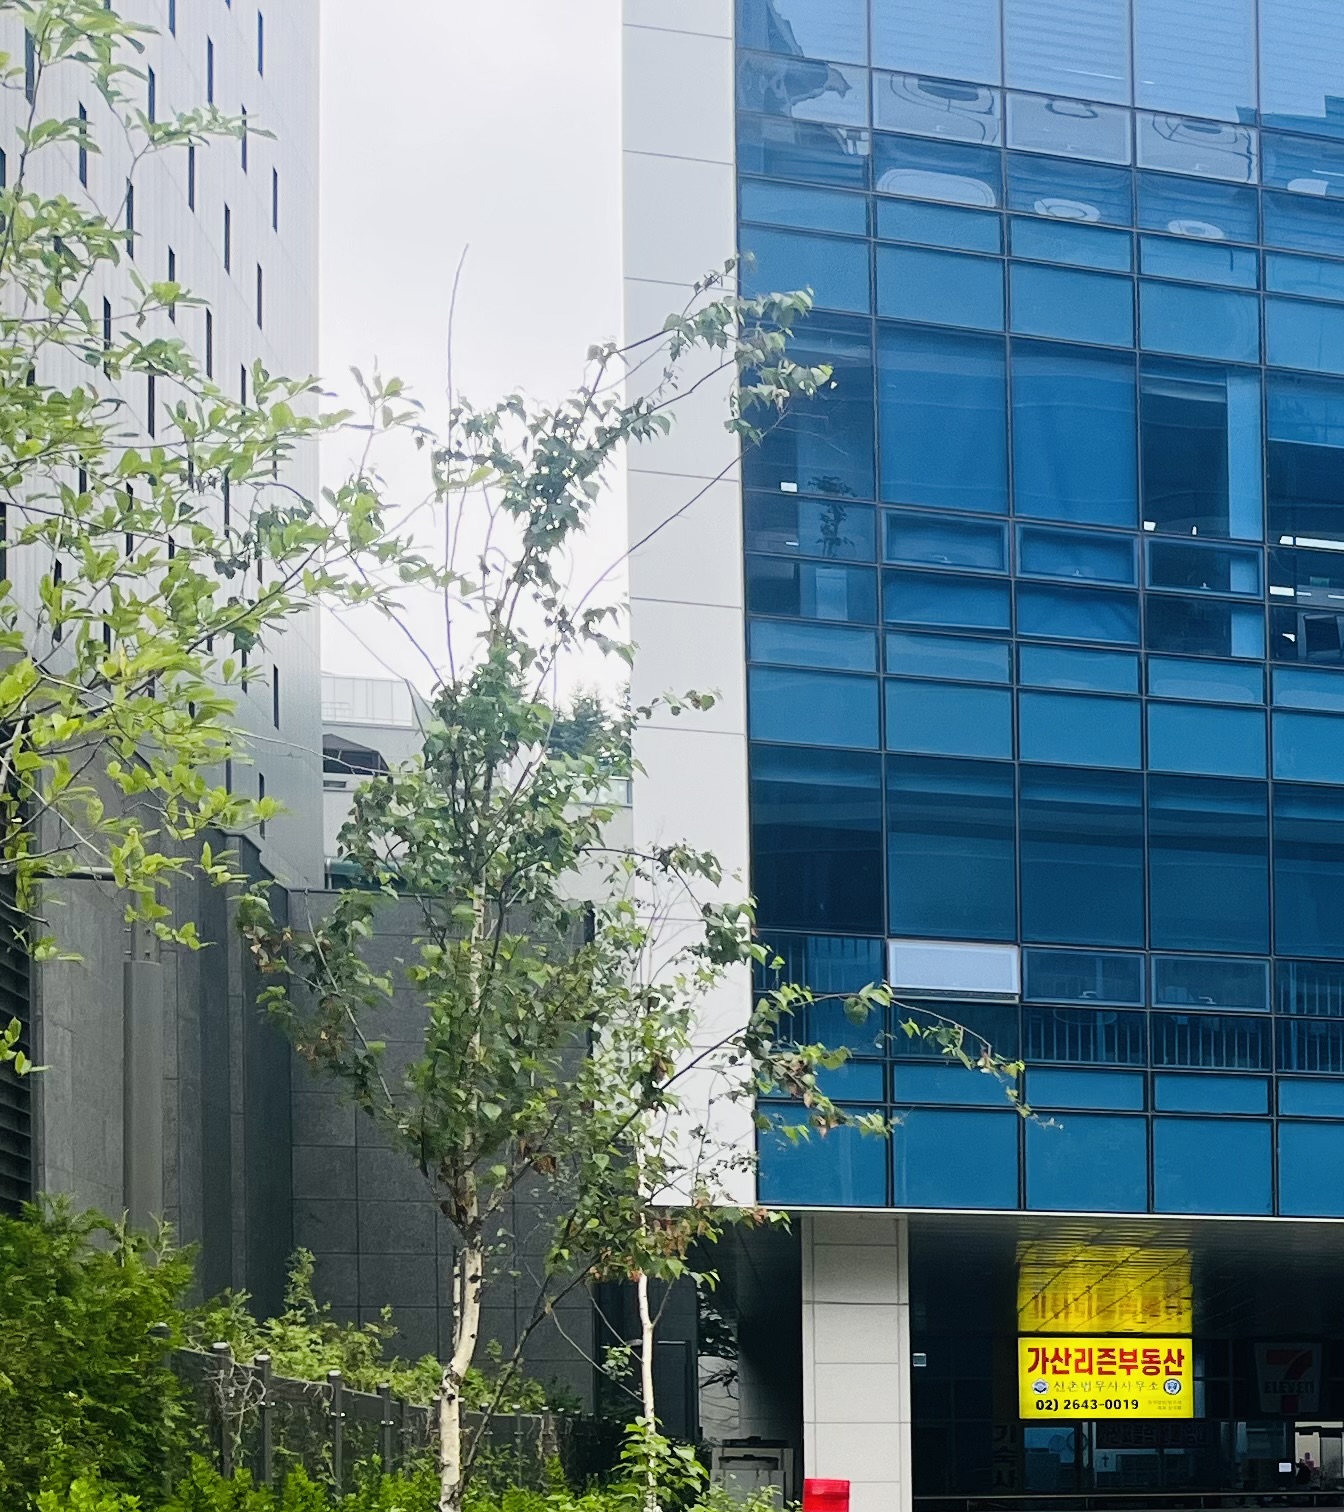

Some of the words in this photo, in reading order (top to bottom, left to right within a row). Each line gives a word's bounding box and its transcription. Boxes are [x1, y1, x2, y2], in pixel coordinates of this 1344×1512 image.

[1027, 1347, 1185, 1376] 가산리즌부동산
[1035, 1399, 1059, 1411] 02)
[1063, 1399, 1139, 1411] 2643-0019
